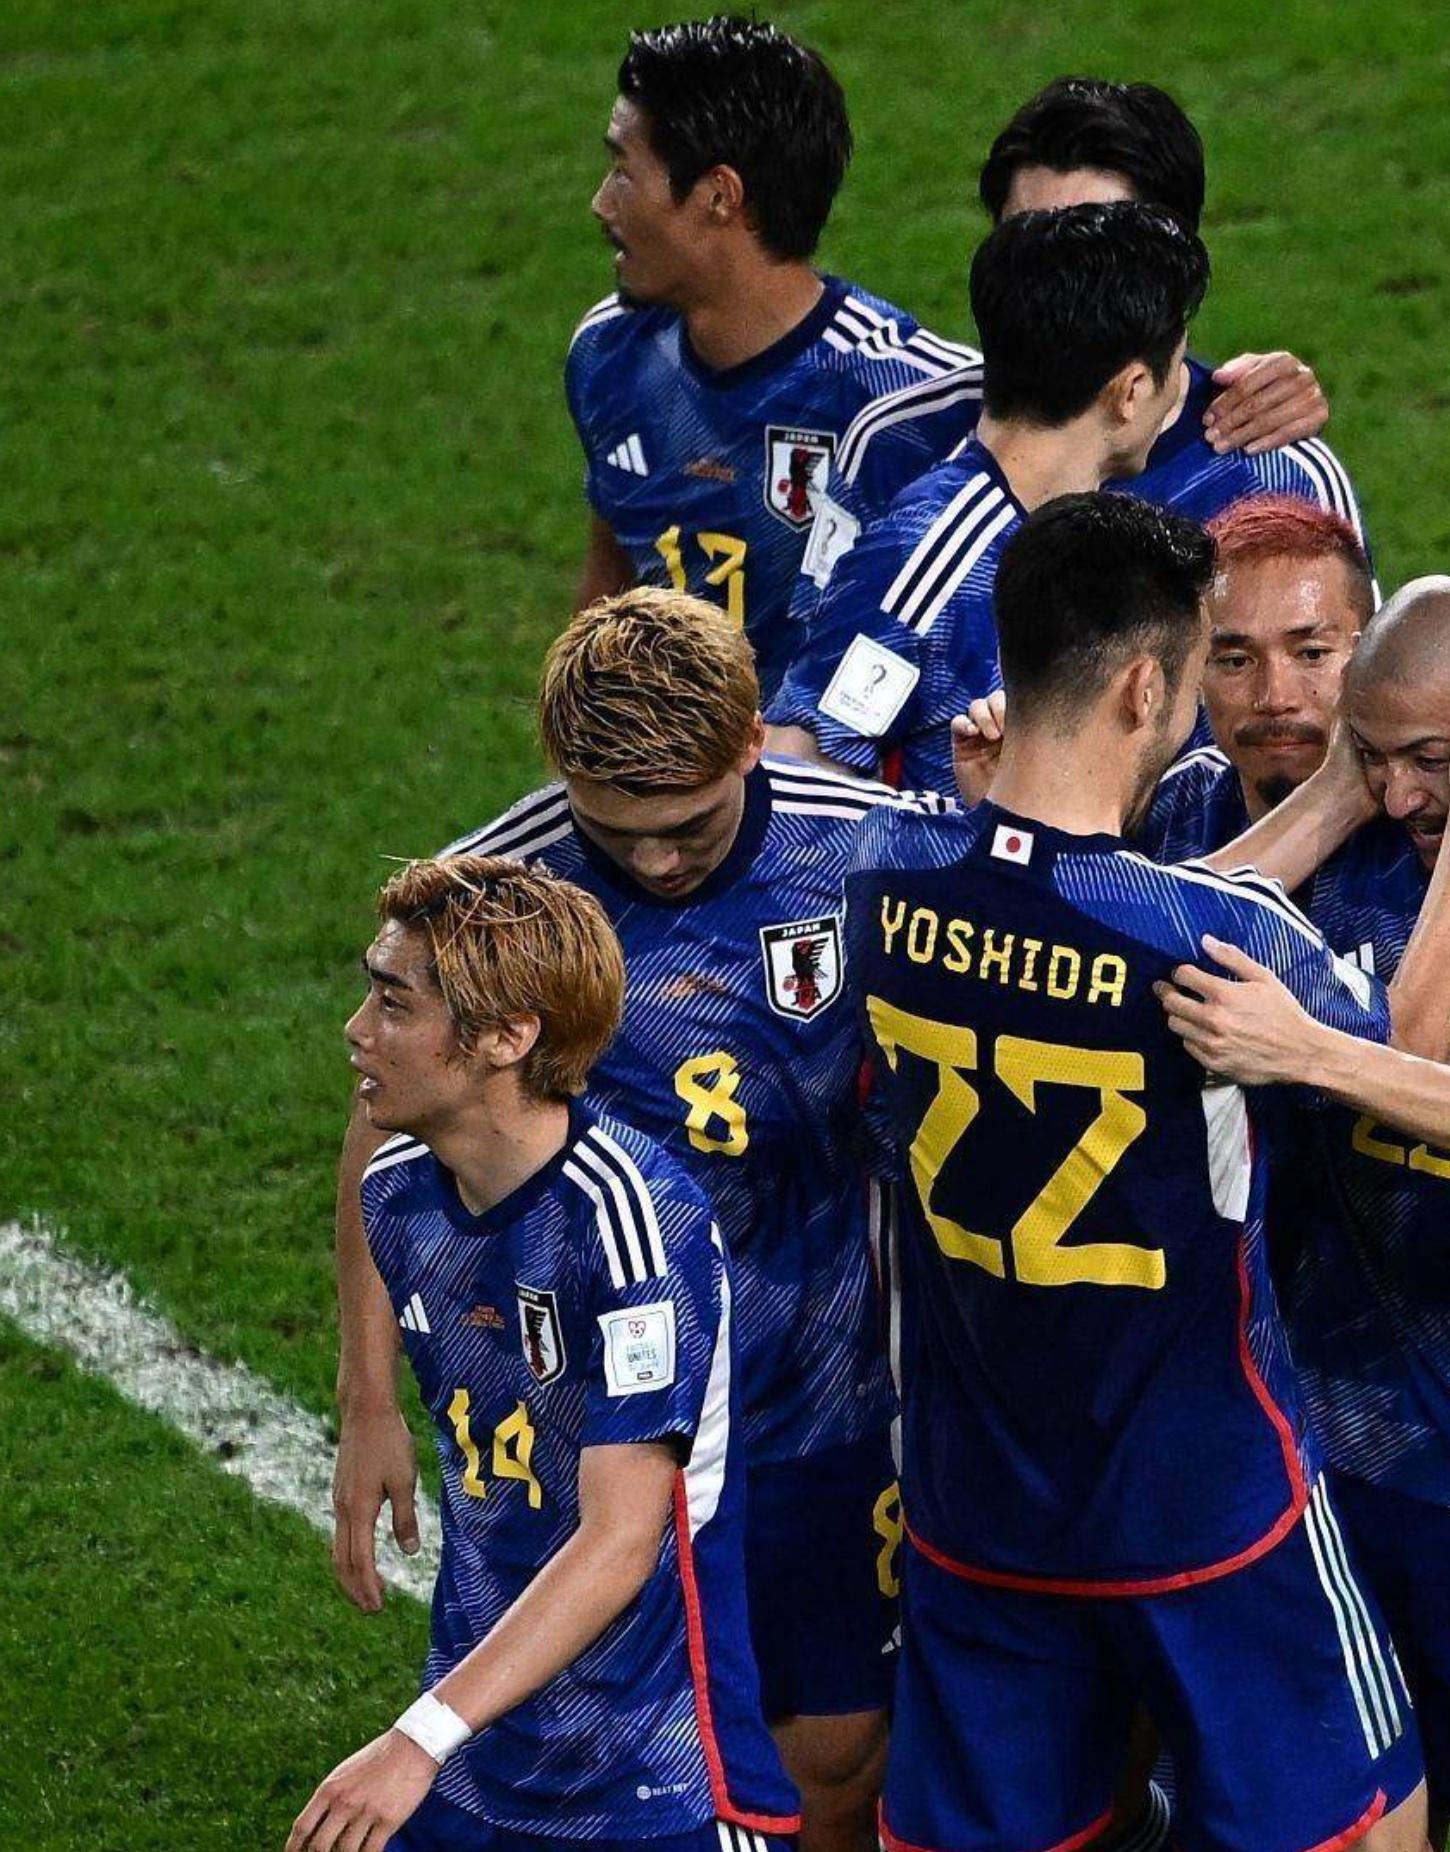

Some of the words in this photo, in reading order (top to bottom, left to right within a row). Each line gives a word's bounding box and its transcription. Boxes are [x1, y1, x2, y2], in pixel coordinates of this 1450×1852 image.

[781, 922, 821, 938] JAPAN
[880, 894, 1127, 1007] YOSHIDA
[674, 1051, 749, 1157] 8
[865, 994, 1167, 1290] 22
[447, 1387, 542, 1510] 14
